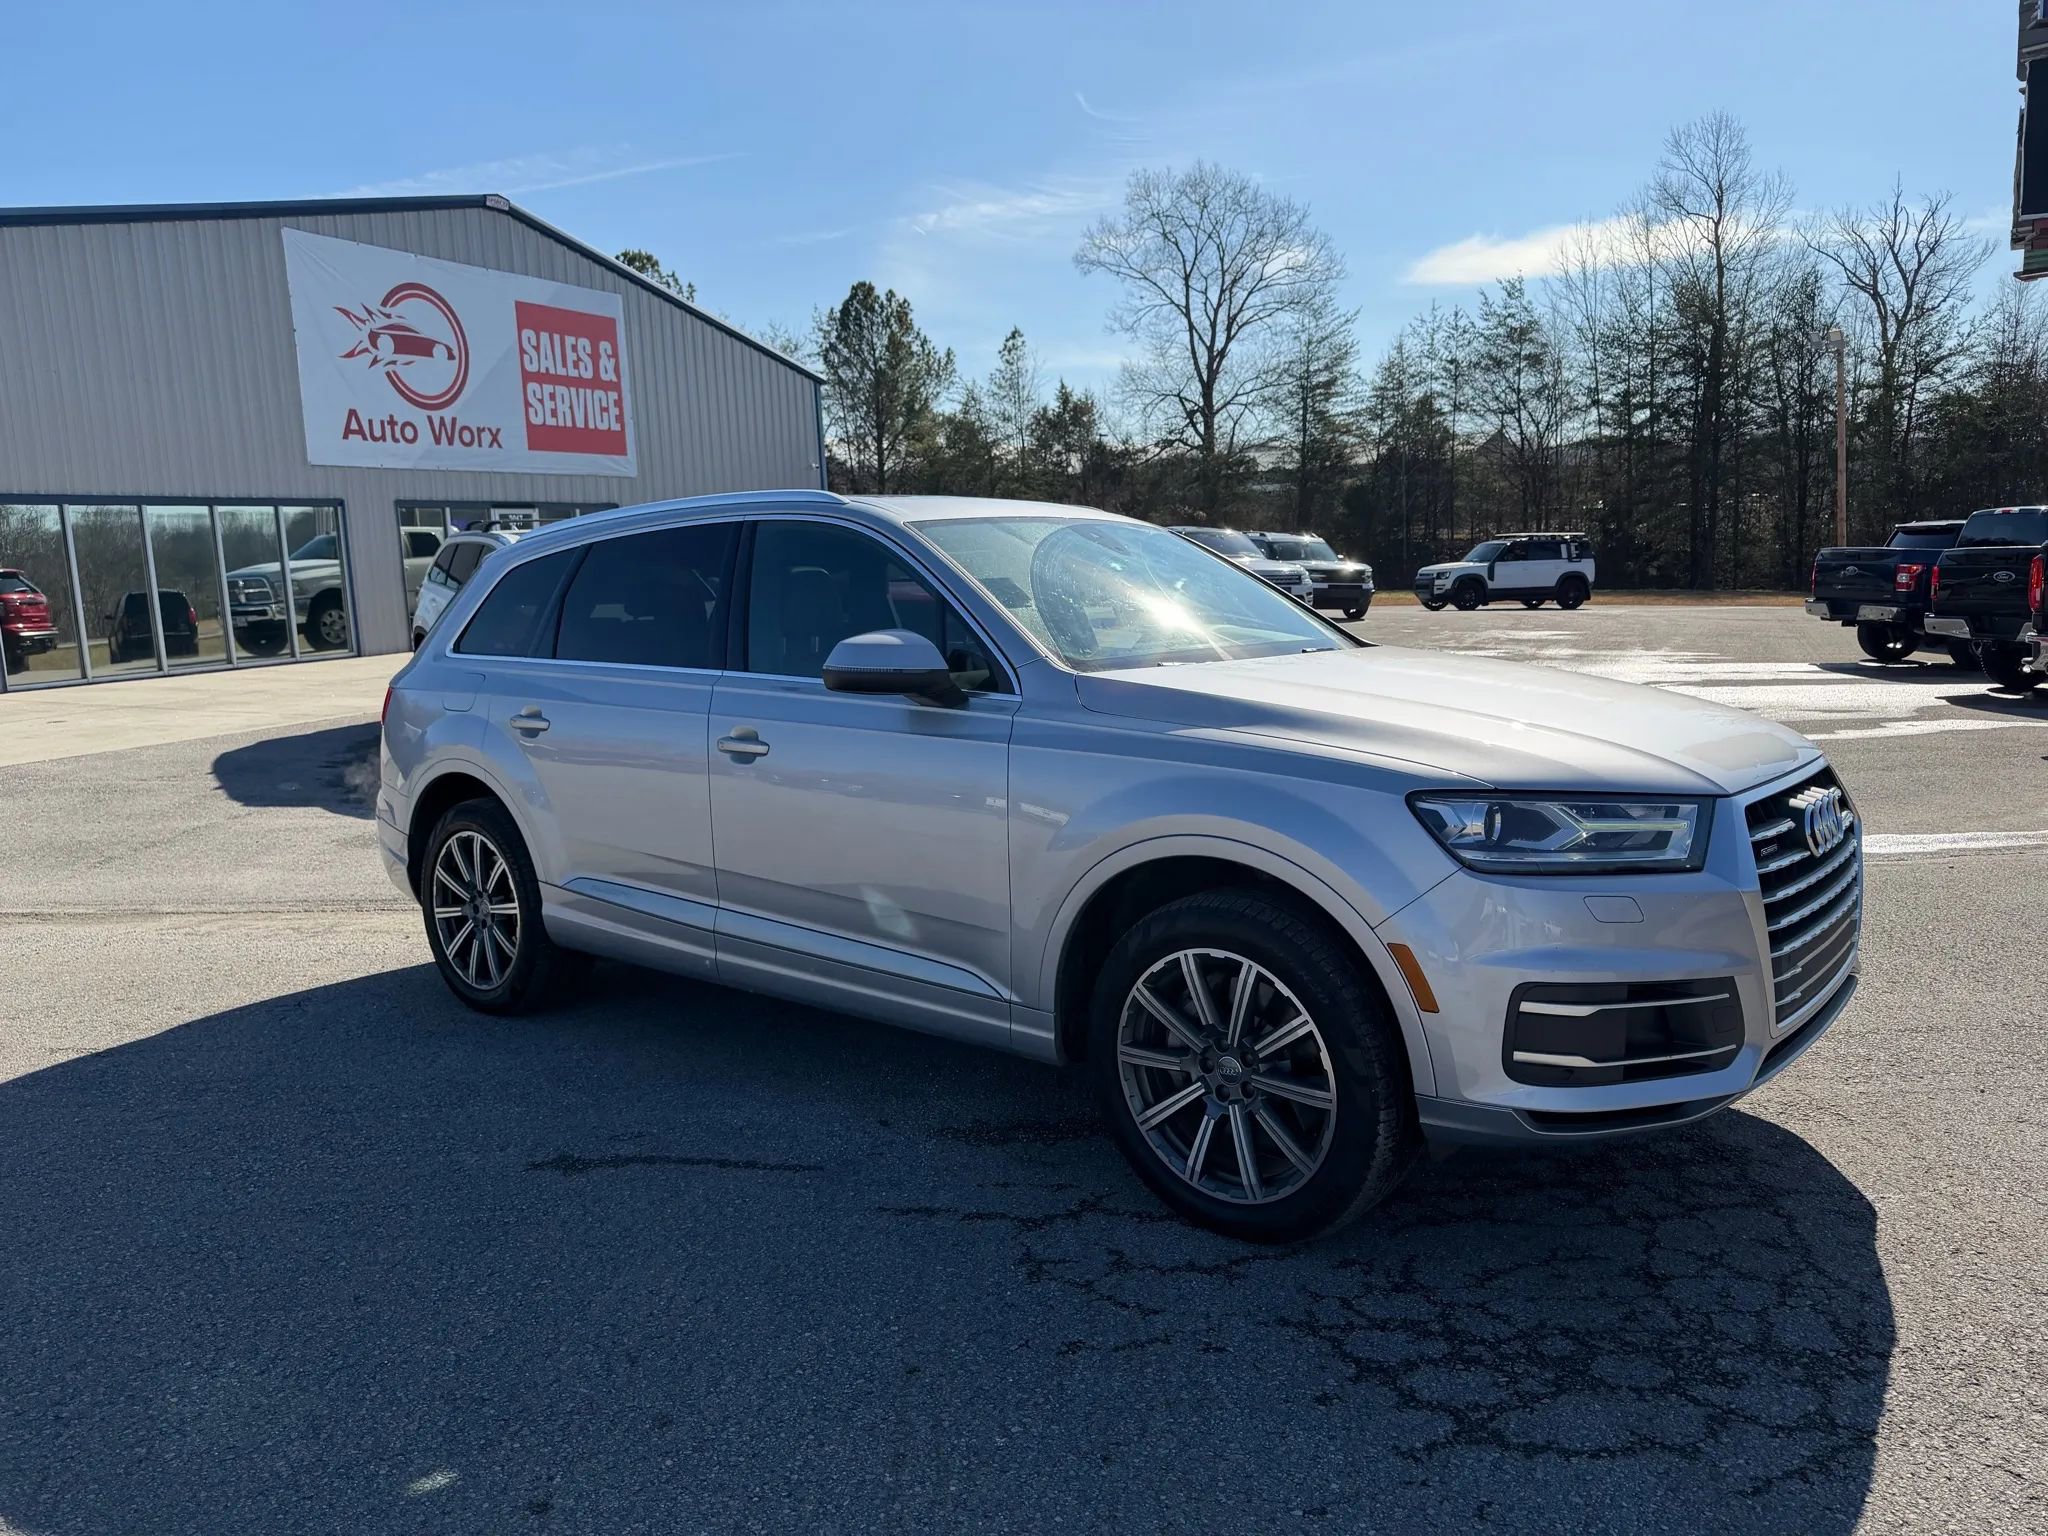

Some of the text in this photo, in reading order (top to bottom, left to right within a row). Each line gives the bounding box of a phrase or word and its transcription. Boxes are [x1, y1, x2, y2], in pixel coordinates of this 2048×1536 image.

[521, 328, 618, 382] SALES &
[342, 408, 503, 449] Auto Worx
[527, 382, 621, 431] SERVICE
